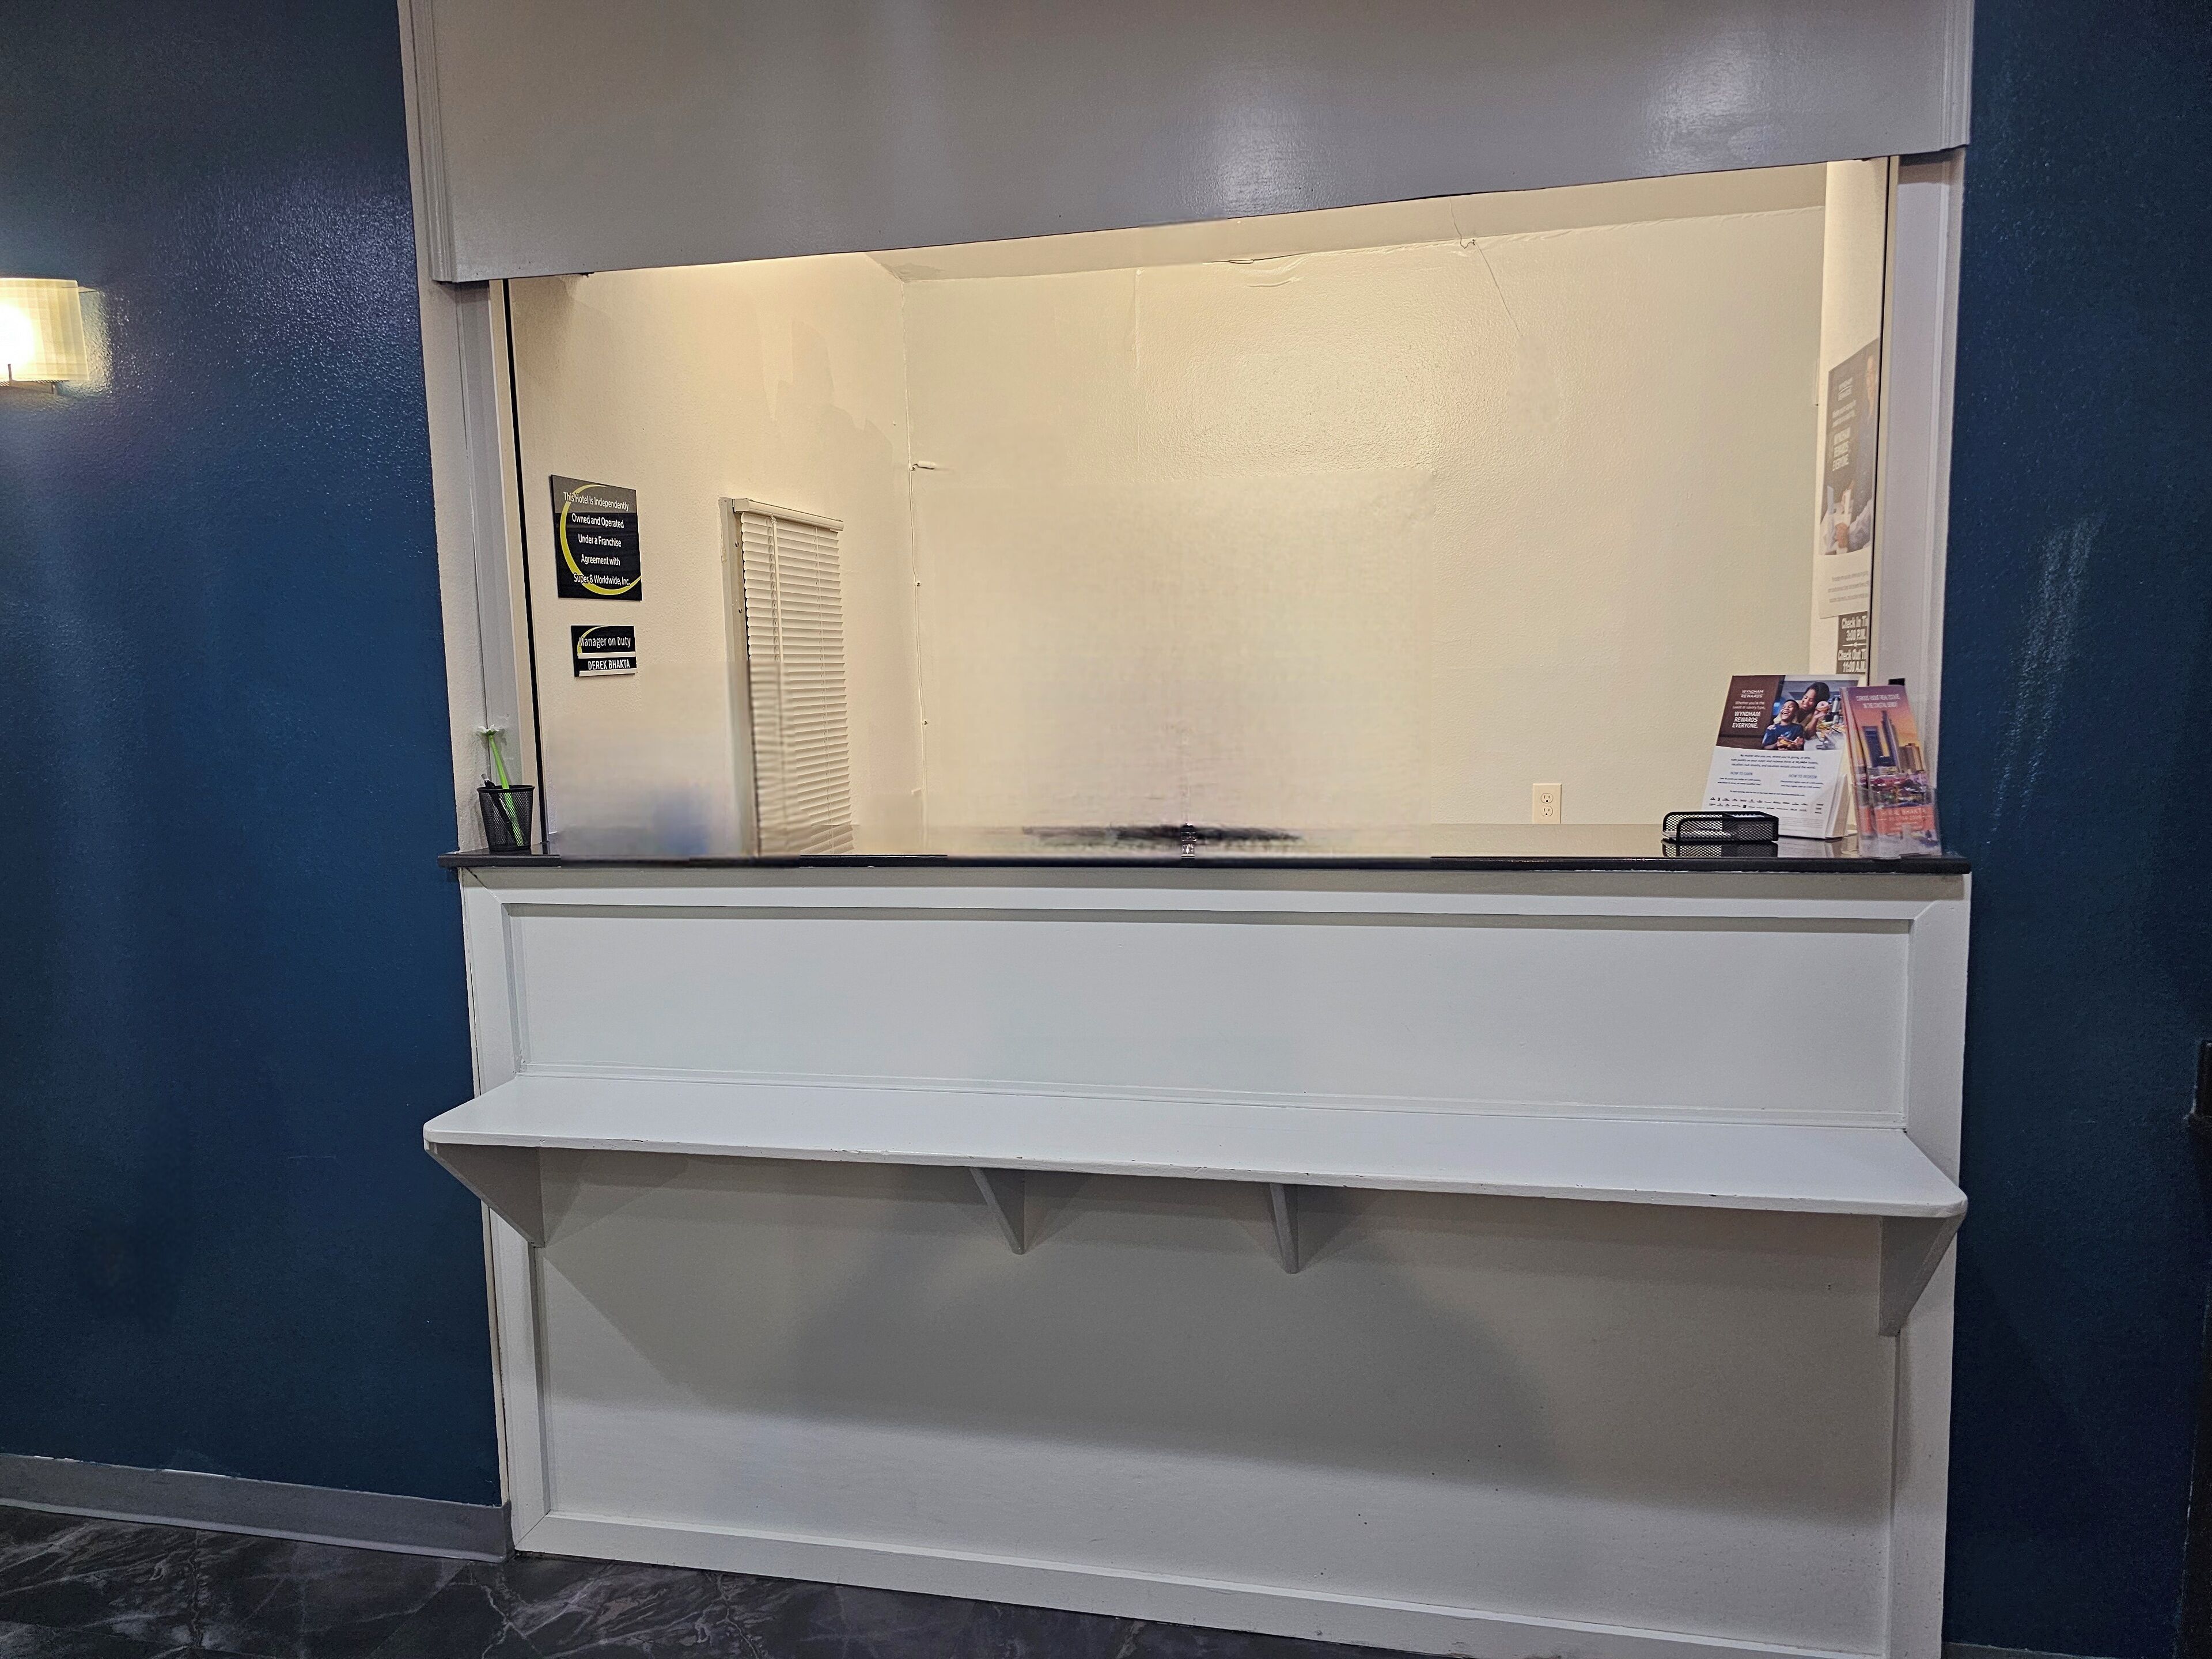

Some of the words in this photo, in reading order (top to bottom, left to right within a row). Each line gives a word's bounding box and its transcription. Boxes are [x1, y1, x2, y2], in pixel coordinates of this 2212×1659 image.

[563, 491, 574, 502] This
[575, 494, 589, 504] Hotel
[589, 496, 594, 505] is
[594, 497, 629, 512] Independently
[571, 513, 590, 524] Owned
[591, 517, 600, 525] and
[601, 517, 624, 528] Operated
[578, 533, 594, 544] Under
[598, 536, 622, 547] Franchise
[581, 554, 609, 565] Agreement
[609, 557, 620, 566] with
[574, 573, 589, 584] Super
[589, 574, 593, 583] 8
[594, 575, 622, 585] Worldwide,
[622, 577, 630, 585] Inc.
[1842, 617, 1855, 629] Check
[1856, 616, 1862, 627] In
[1846, 630, 1856, 641] 3:00
[579, 637, 607, 649] Manager
[608, 638, 616, 646] on
[617, 637, 631, 647] Duty
[1838, 649, 1852, 661] Check
[1852, 649, 1861, 660] Out
[588, 660, 608, 670] DEREK
[608, 659, 630, 669] BHAKTA
[1843, 661, 1855, 672] 11:00
